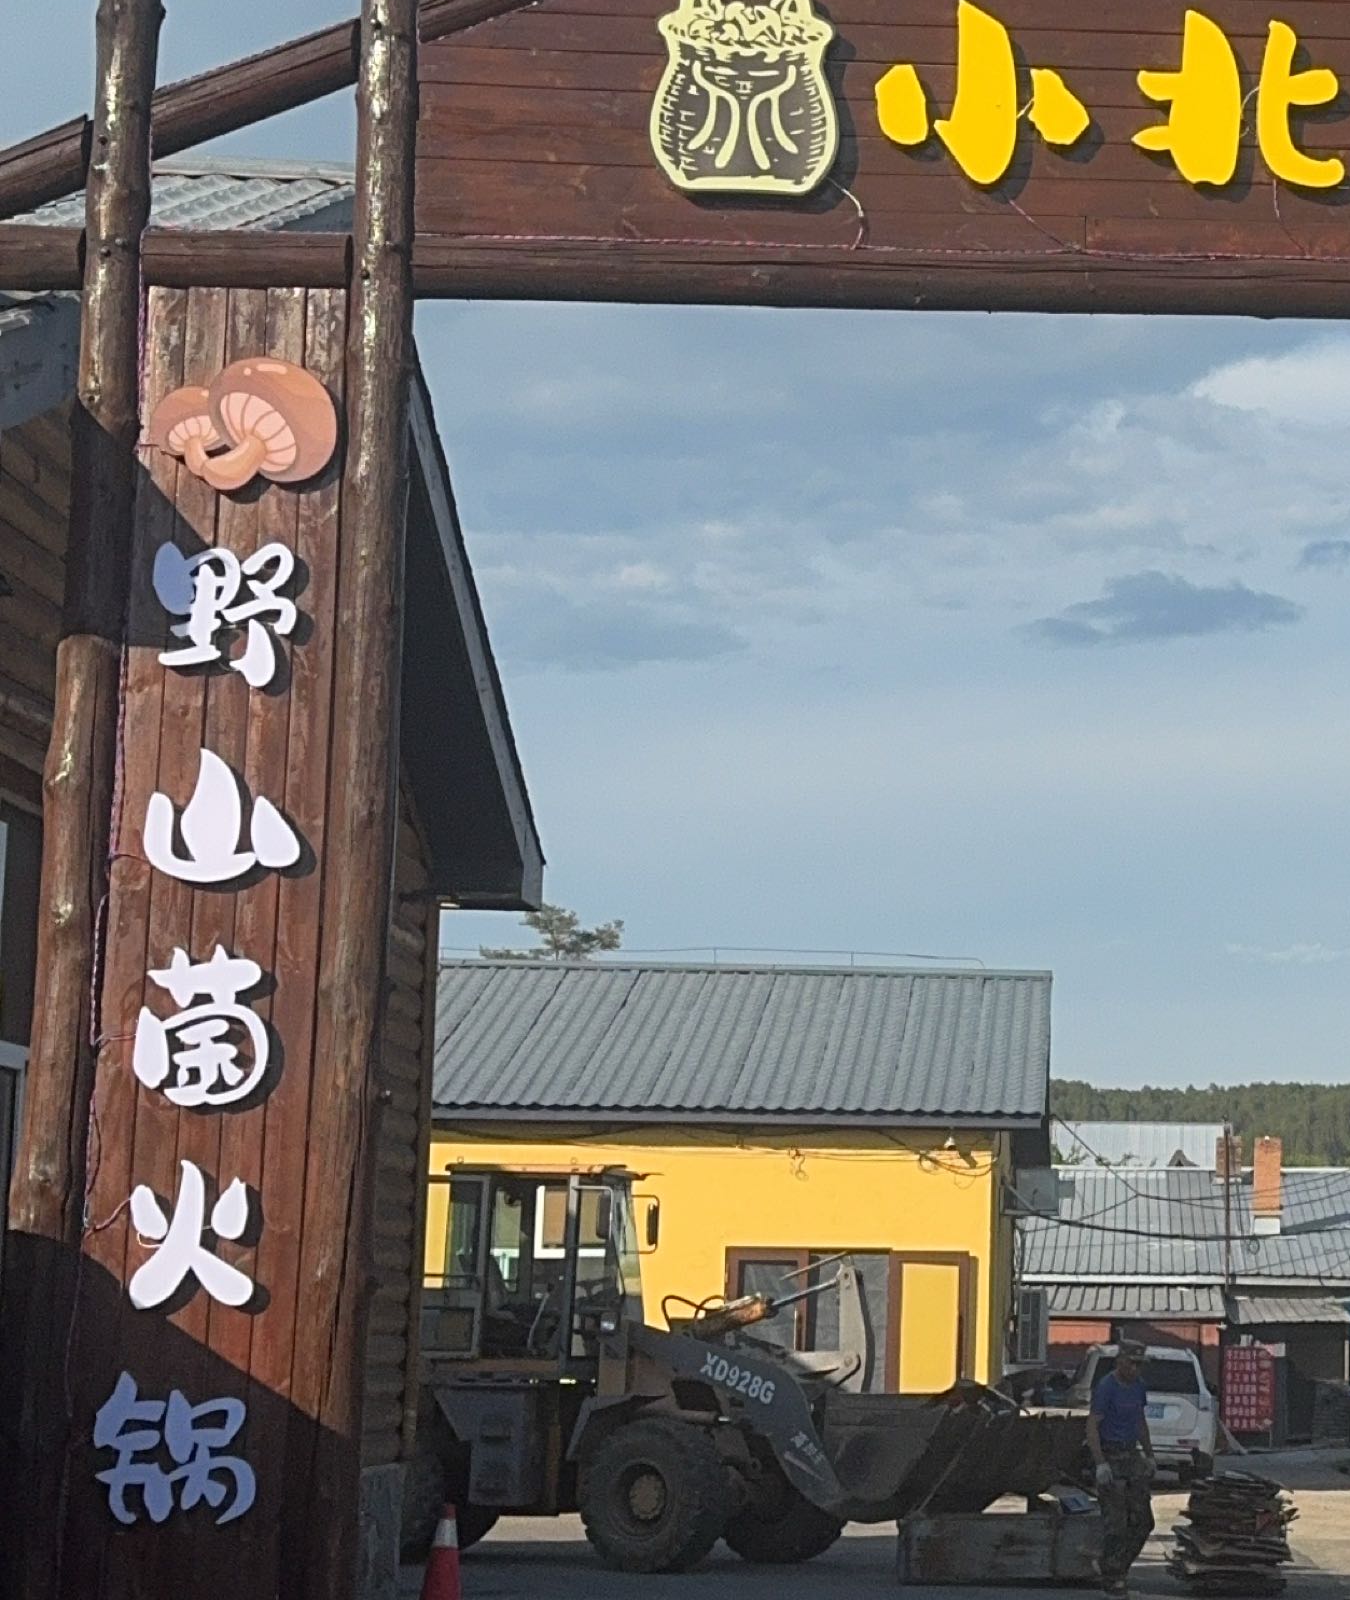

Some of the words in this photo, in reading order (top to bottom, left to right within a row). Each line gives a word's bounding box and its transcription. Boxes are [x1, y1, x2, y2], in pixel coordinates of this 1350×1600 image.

[92, 538, 303, 1525] 野山菌火锅
[700, 1351, 776, 1405] XD928G
